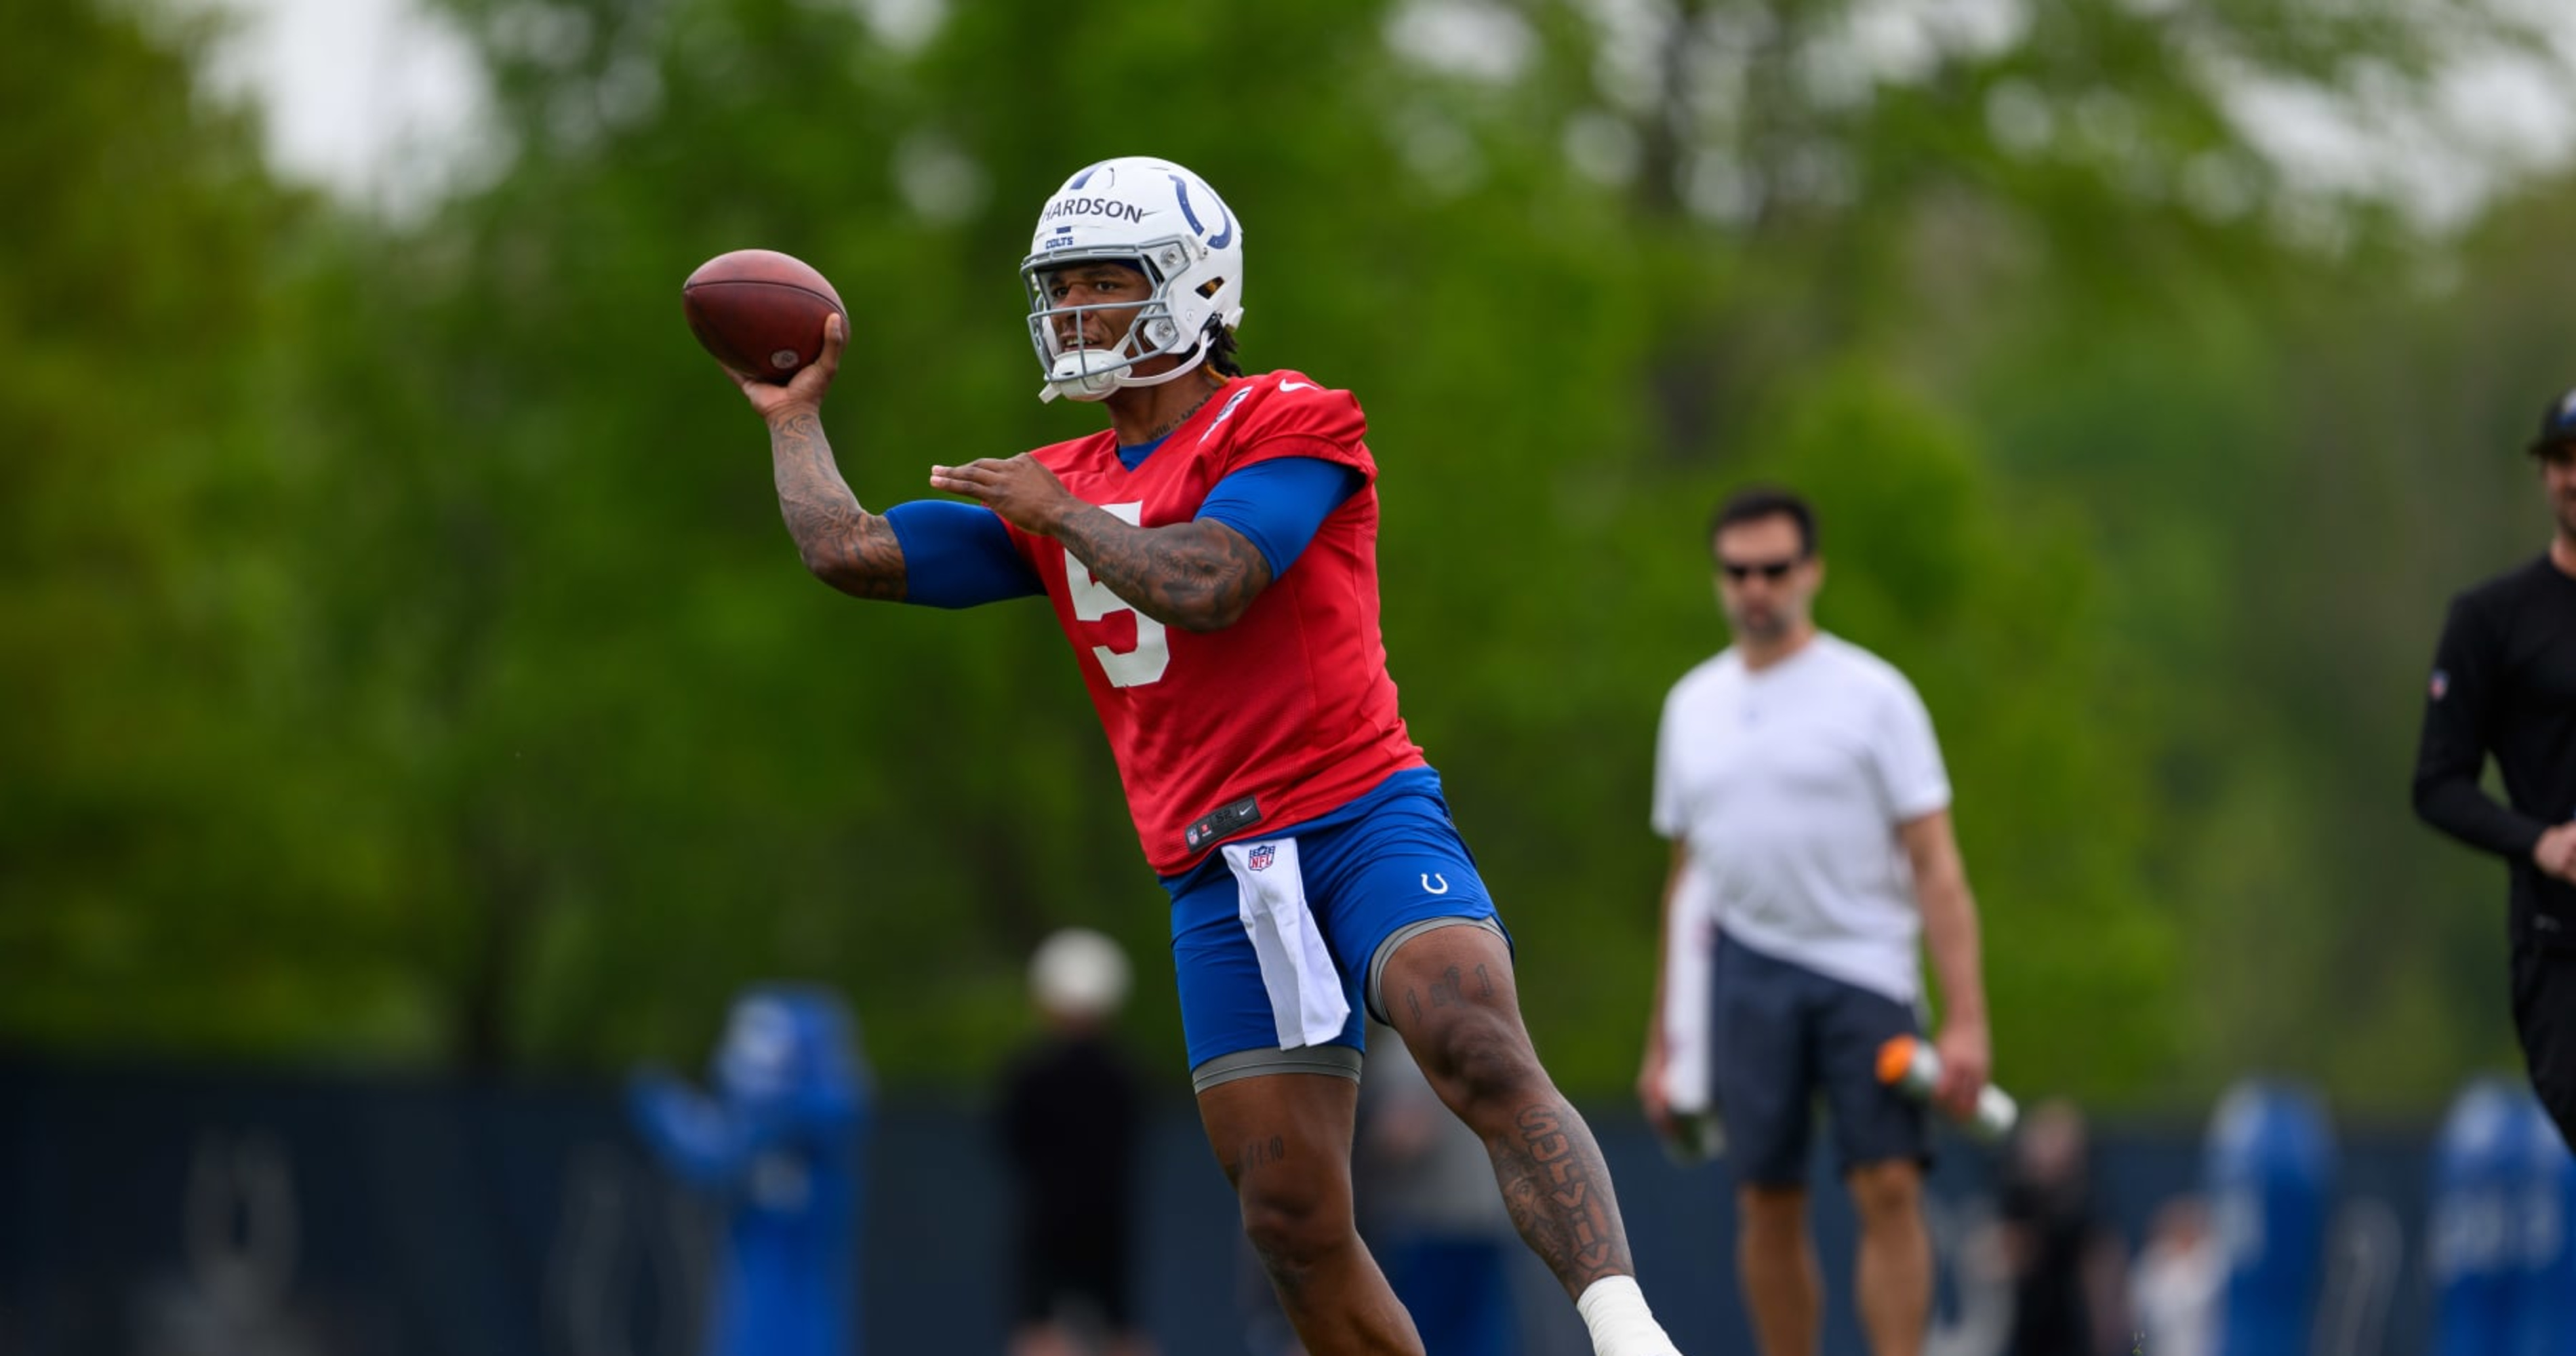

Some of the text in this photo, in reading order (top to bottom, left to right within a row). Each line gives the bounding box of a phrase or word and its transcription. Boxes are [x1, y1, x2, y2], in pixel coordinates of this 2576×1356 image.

[1046, 237, 1074, 249] COLTS
[1064, 500, 1170, 687] 5
[1251, 854, 1272, 869] NFL
